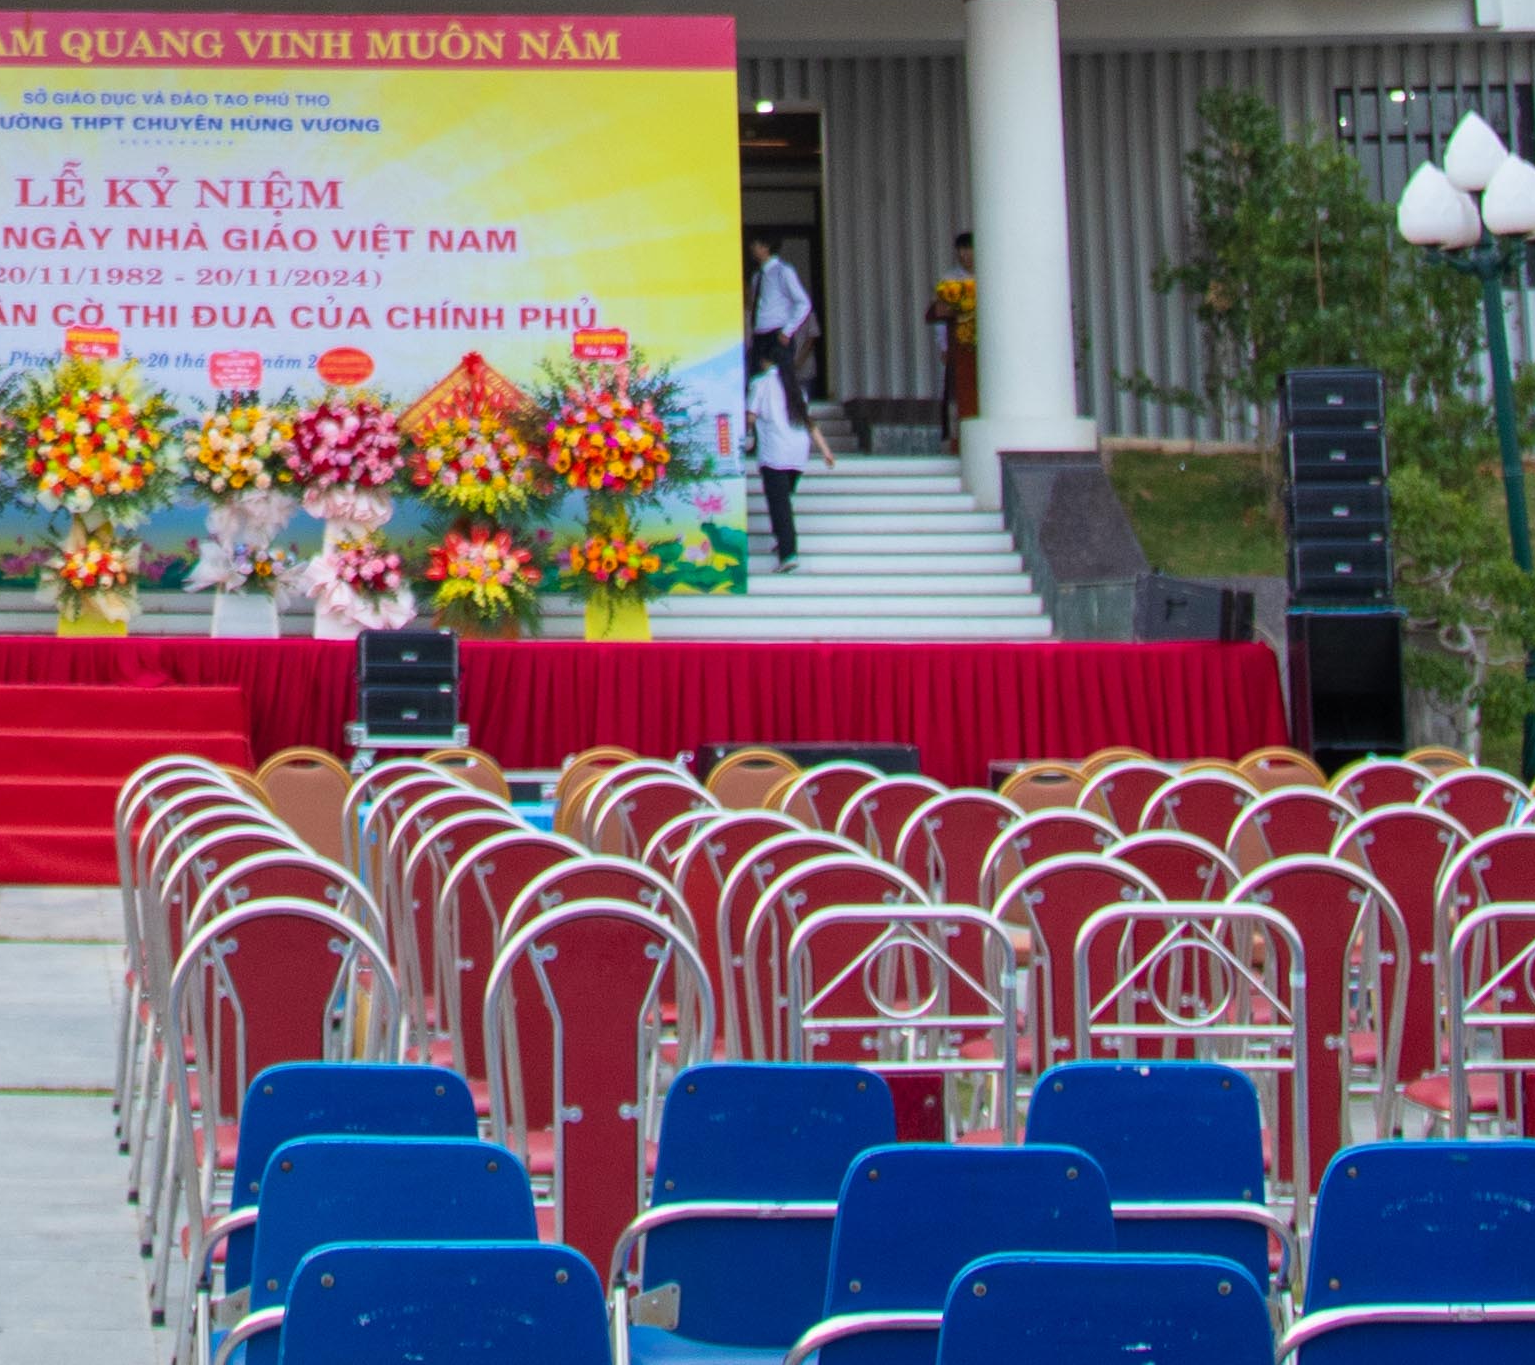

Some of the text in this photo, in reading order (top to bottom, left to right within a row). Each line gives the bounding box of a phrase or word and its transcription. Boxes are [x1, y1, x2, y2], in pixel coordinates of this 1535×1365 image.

[60, 27, 226, 64] QUANG
[235, 29, 354, 61] VINH
[366, 21, 506, 61] MUÔN
[518, 26, 622, 61] NĂM
[23, 88, 48, 106] SỞ
[52, 90, 96, 106] GIÁO
[142, 89, 166, 106] VÀ
[170, 90, 208, 106] ĐÀO
[254, 90, 289, 107] PHÚ
[72, 116, 125, 131] THPT
[133, 113, 223, 132] CHUYÊN
[231, 114, 293, 132] HÙNG
[301, 116, 380, 133] VƯƠNG
[15, 161, 345, 217] LỄ KỶ NIỆM
[3, 221, 112, 250] NGÀY
[128, 222, 208, 251] NHÀ
[222, 222, 317, 252] GIÁO
[331, 223, 414, 260] VIỆT
[428, 229, 518, 253] NAM
[197, 268, 382, 288] 20/11/2024)
[51, 298, 106, 327] CỜ
[119, 304, 178, 328] THI
[192, 305, 276, 329] ĐUA
[290, 295, 372, 329] CỦA
[386, 299, 506, 330] CHÍNH
[520, 296, 598, 330] PHỦ
